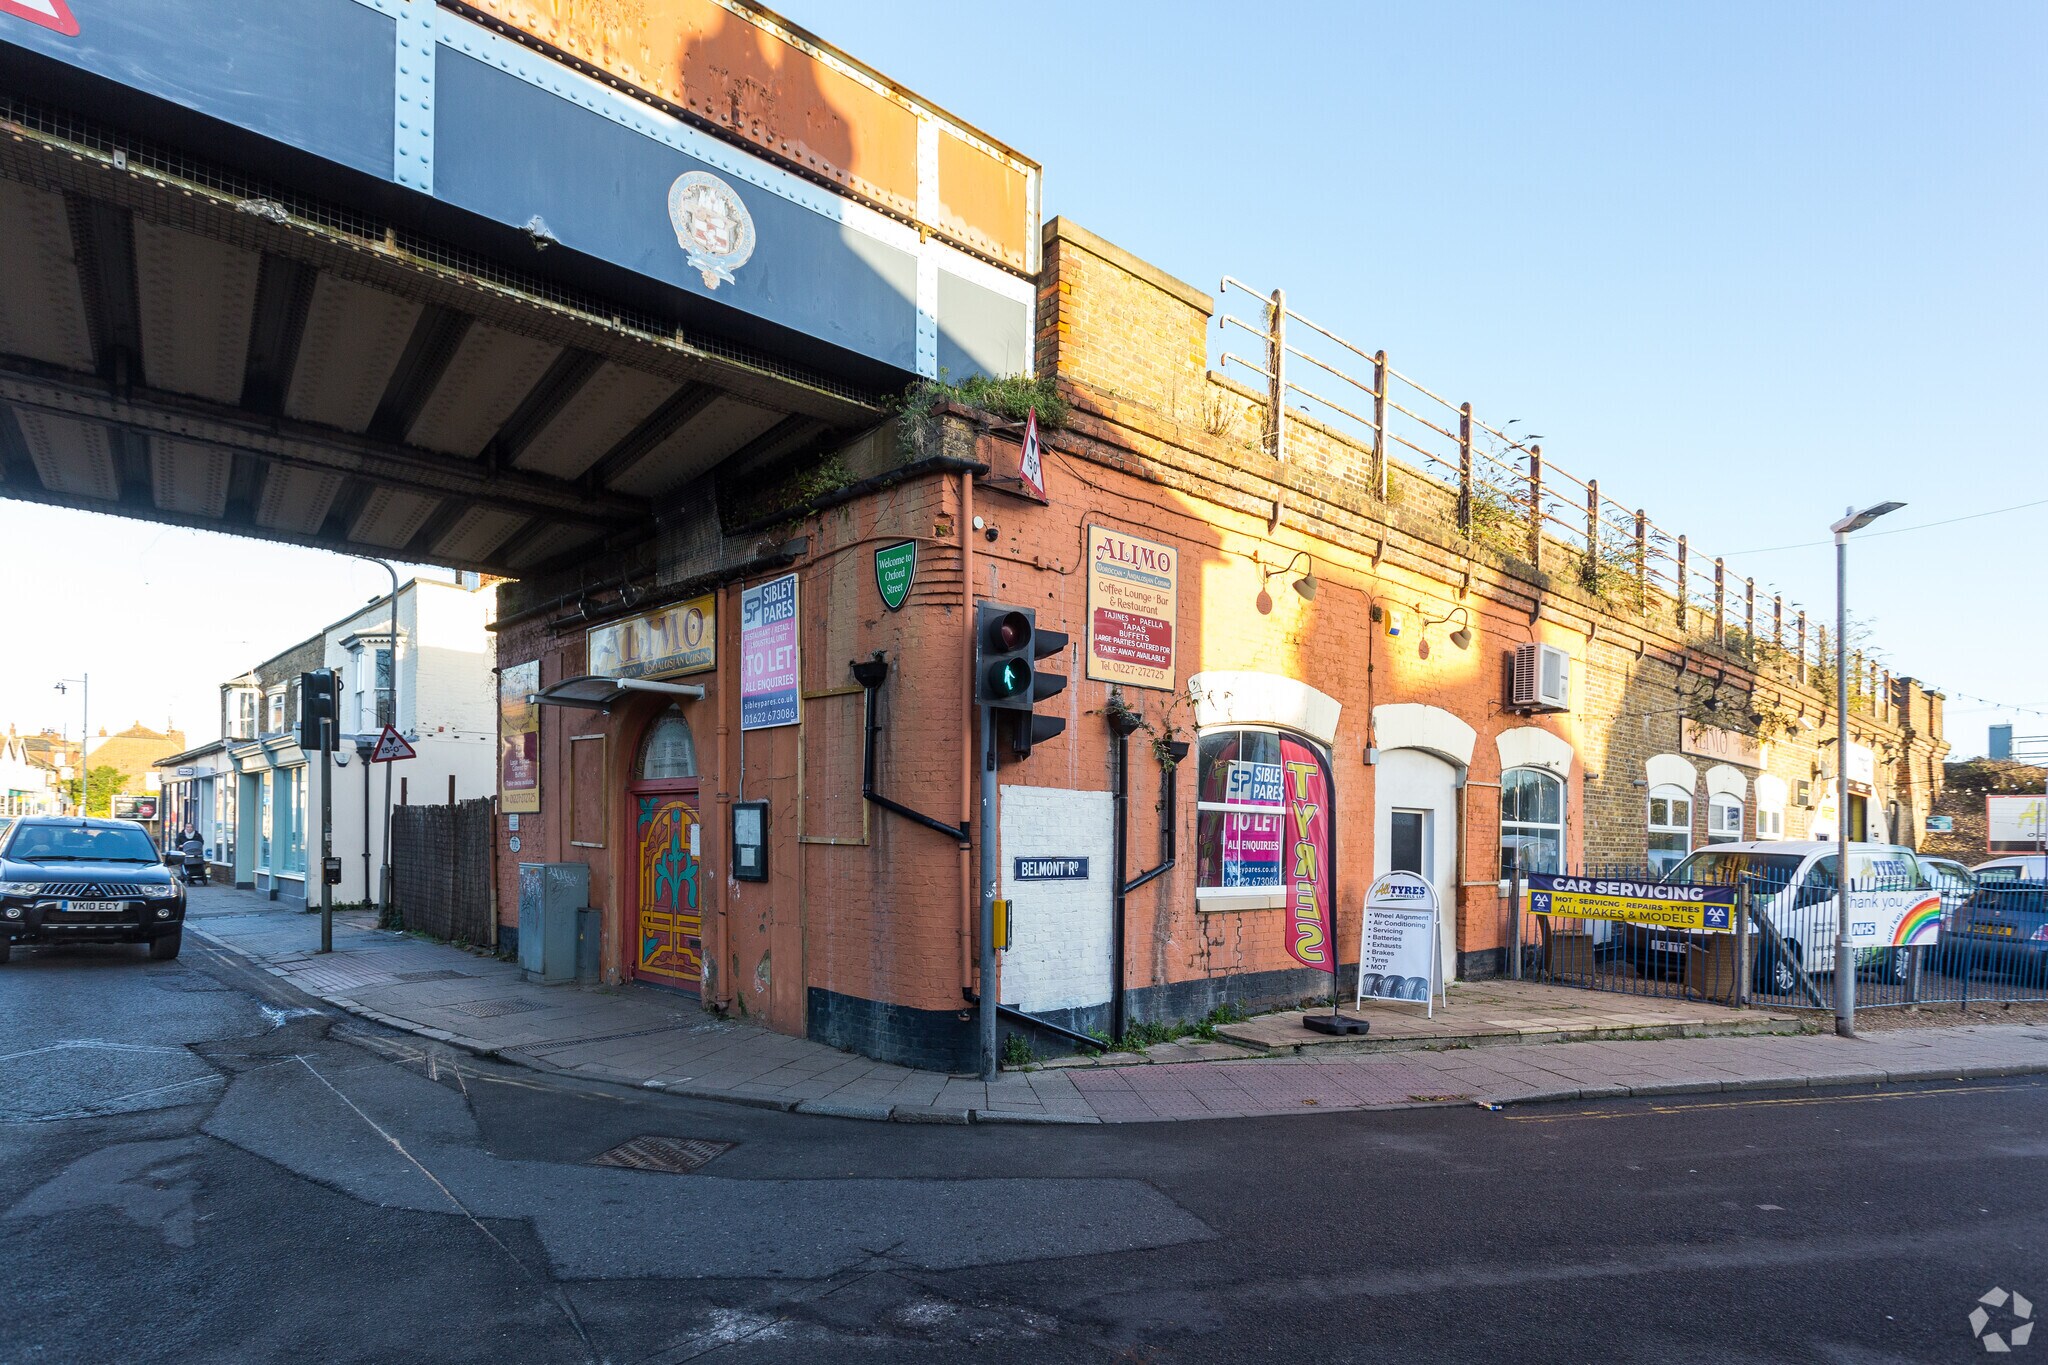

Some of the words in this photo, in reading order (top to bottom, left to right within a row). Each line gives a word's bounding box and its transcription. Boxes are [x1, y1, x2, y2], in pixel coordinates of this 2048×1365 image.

[879, 556, 905, 569] Welcome
[906, 554, 912, 562] to
[1096, 537, 1171, 572] ALIMO
[885, 567, 905, 581] Oxford
[763, 579, 793, 604] SIBLEY
[887, 583, 903, 594] Street
[1098, 581, 1123, 595] Coffee
[1124, 587, 1152, 604] Lounge
[1156, 594, 1169, 605] Bar
[763, 599, 794, 623] PARES
[1110, 596, 1116, 606] &
[1117, 598, 1158, 615] Restaurant
[1104, 611, 1129, 622] TAJINES
[1140, 618, 1163, 629] PAELLA
[1122, 622, 1146, 633] TAPAS
[594, 608, 704, 676] ALIMO
[1095, 634, 1112, 643] LARGE
[1113, 637, 1135, 647] PARTIES
[1136, 642, 1159, 652] CATERED
[1119, 630, 1150, 641] BUFFETS
[746, 652, 764, 677] TO
[768, 645, 793, 672] LET
[1099, 644, 1136, 657] TAKE-AWAY
[1136, 652, 1166, 663] AVAILABLE
[745, 681, 756, 693] ALL
[758, 673, 794, 691] ENQUIRIES
[745, 694, 794, 710] sibleypares.co.uk
[744, 712, 766, 724] 01622
[767, 708, 795, 721] 673086
[1252, 783, 1285, 801] PARES
[1230, 812, 1250, 831] TO
[1254, 813, 1280, 832] LET
[1241, 841, 1279, 852] ENQUIRIES
[1021, 861, 1065, 877] BELMONT
[1872, 860, 1907, 876] TYRES
[1374, 883, 1391, 898] All
[1390, 886, 1425, 895] TYRES
[1552, 878, 1592, 893] CAR
[1594, 881, 1704, 901] SERVICING
[71, 902, 96, 911] VK10
[98, 902, 120, 911] ECY
[1579, 898, 1620, 907] SERVICNG
[1626, 902, 1663, 911] REPAIRS
[1669, 905, 1700, 913] TYRES
[1882, 897, 1903, 911] you
[1557, 904, 1579, 914] ALL
[1582, 906, 1625, 918] MAKES
[1628, 910, 1636, 919] &
[1640, 911, 1695, 924] MODELS
[1372, 927, 1403, 935] Servicing
[1384, 920, 1426, 929] Conditioning
[1852, 923, 1875, 935] NHS
[1372, 934, 1402, 942] Batteries
